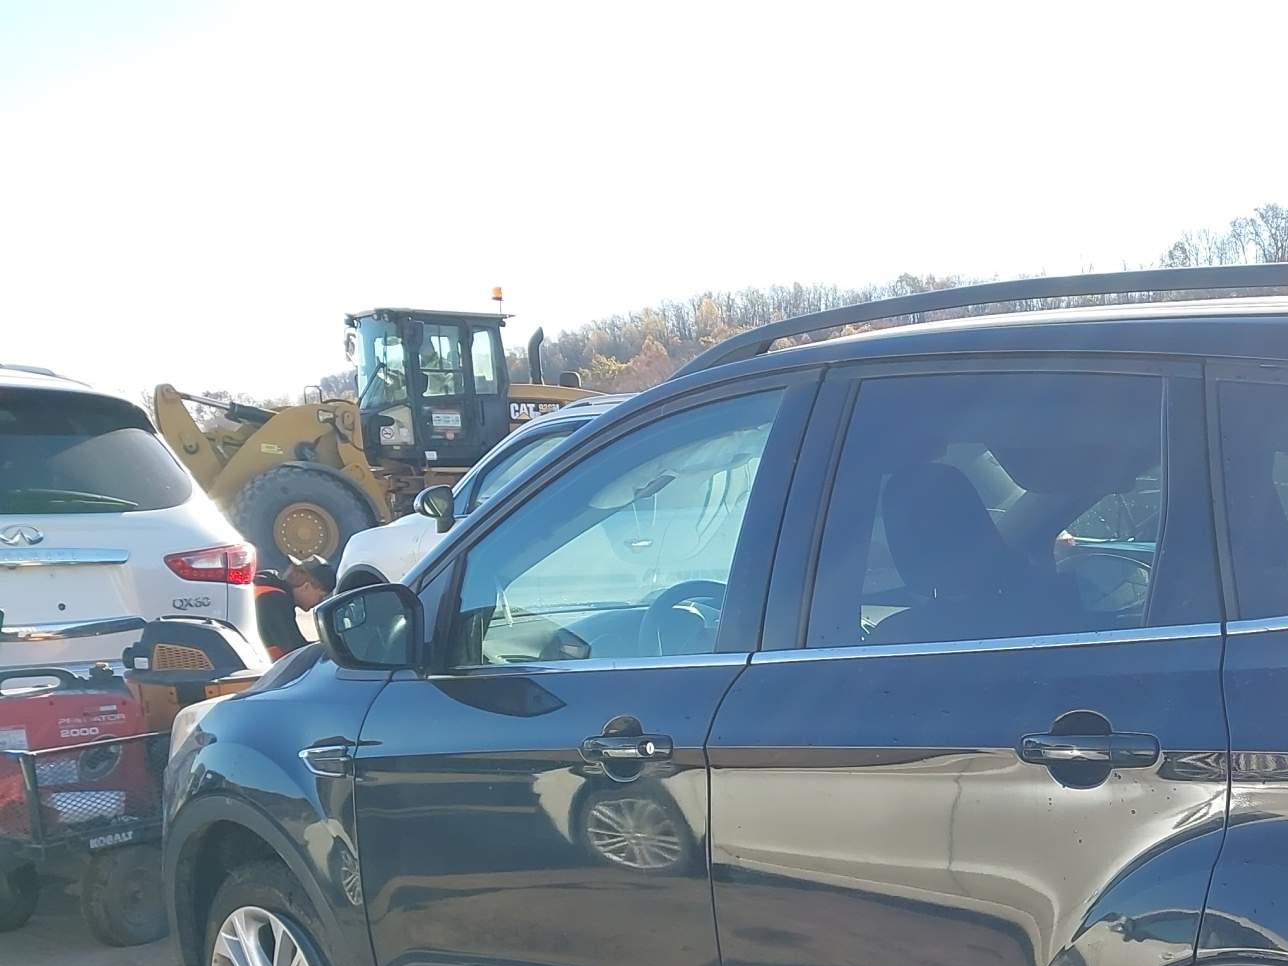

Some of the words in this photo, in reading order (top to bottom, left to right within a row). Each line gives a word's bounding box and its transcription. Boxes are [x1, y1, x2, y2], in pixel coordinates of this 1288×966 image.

[509, 403, 536, 420] CAT
[172, 597, 211, 611] QX60
[60, 727, 100, 738] 2000
[89, 831, 134, 849] KOBALT
